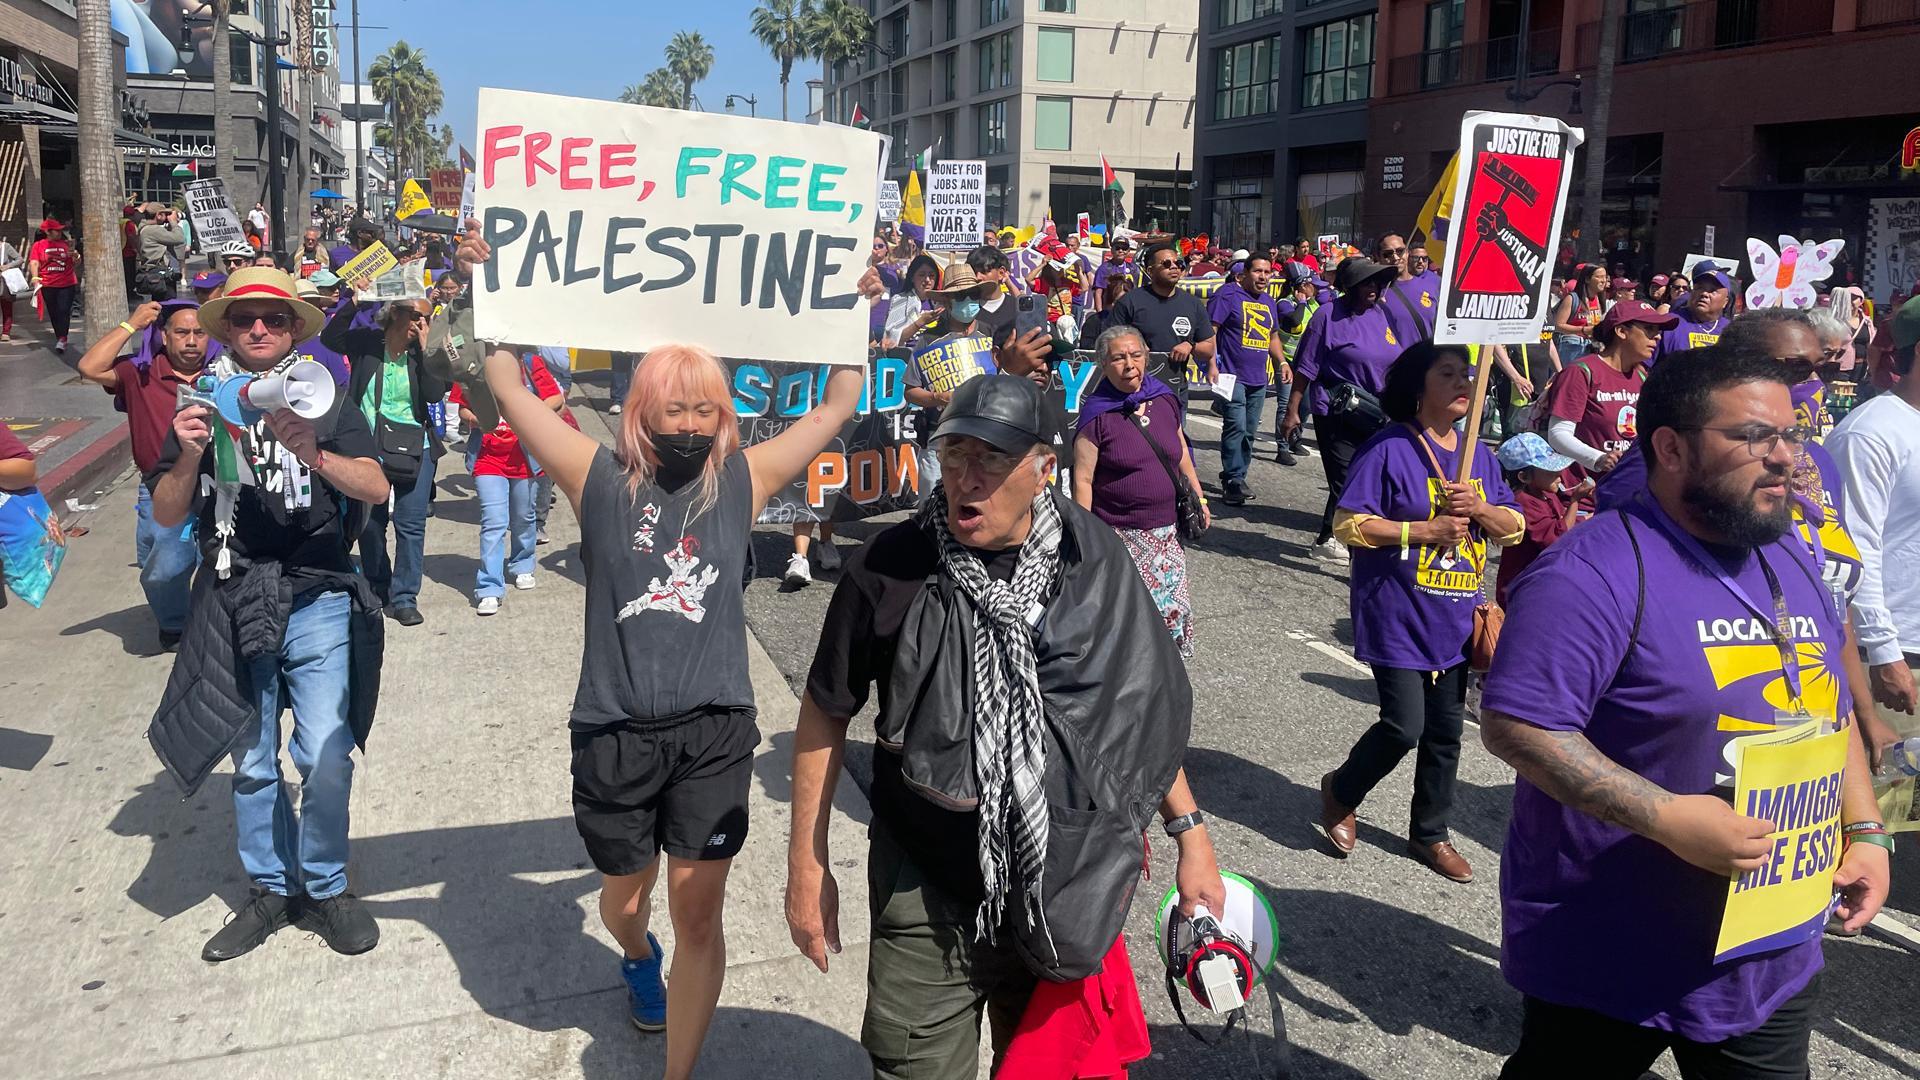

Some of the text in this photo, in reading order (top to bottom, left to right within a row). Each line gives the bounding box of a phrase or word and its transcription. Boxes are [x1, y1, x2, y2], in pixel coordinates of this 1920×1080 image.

[1486, 128, 1560, 158] JUSTICE FOR
[484, 125, 863, 223] FREE, FREE,
[931, 164, 982, 176] MONEY FOR
[193, 188, 213, 198] READY
[934, 178, 979, 190] JOBS AND
[192, 196, 228, 212] STRIKE
[930, 194, 981, 205] EDUCATION
[206, 217, 226, 228] UG2
[931, 216, 978, 232] WAR &
[928, 233, 980, 242] OCCUPATION!
[484, 207, 859, 317] PALESTINE
[1497, 228, 1546, 285] JUSTICIA!
[1456, 294, 1530, 319] JANITORS
[918, 348, 943, 370] KEEP
[922, 354, 976, 384] TOGETHR
[894, 414, 918, 440] IS
